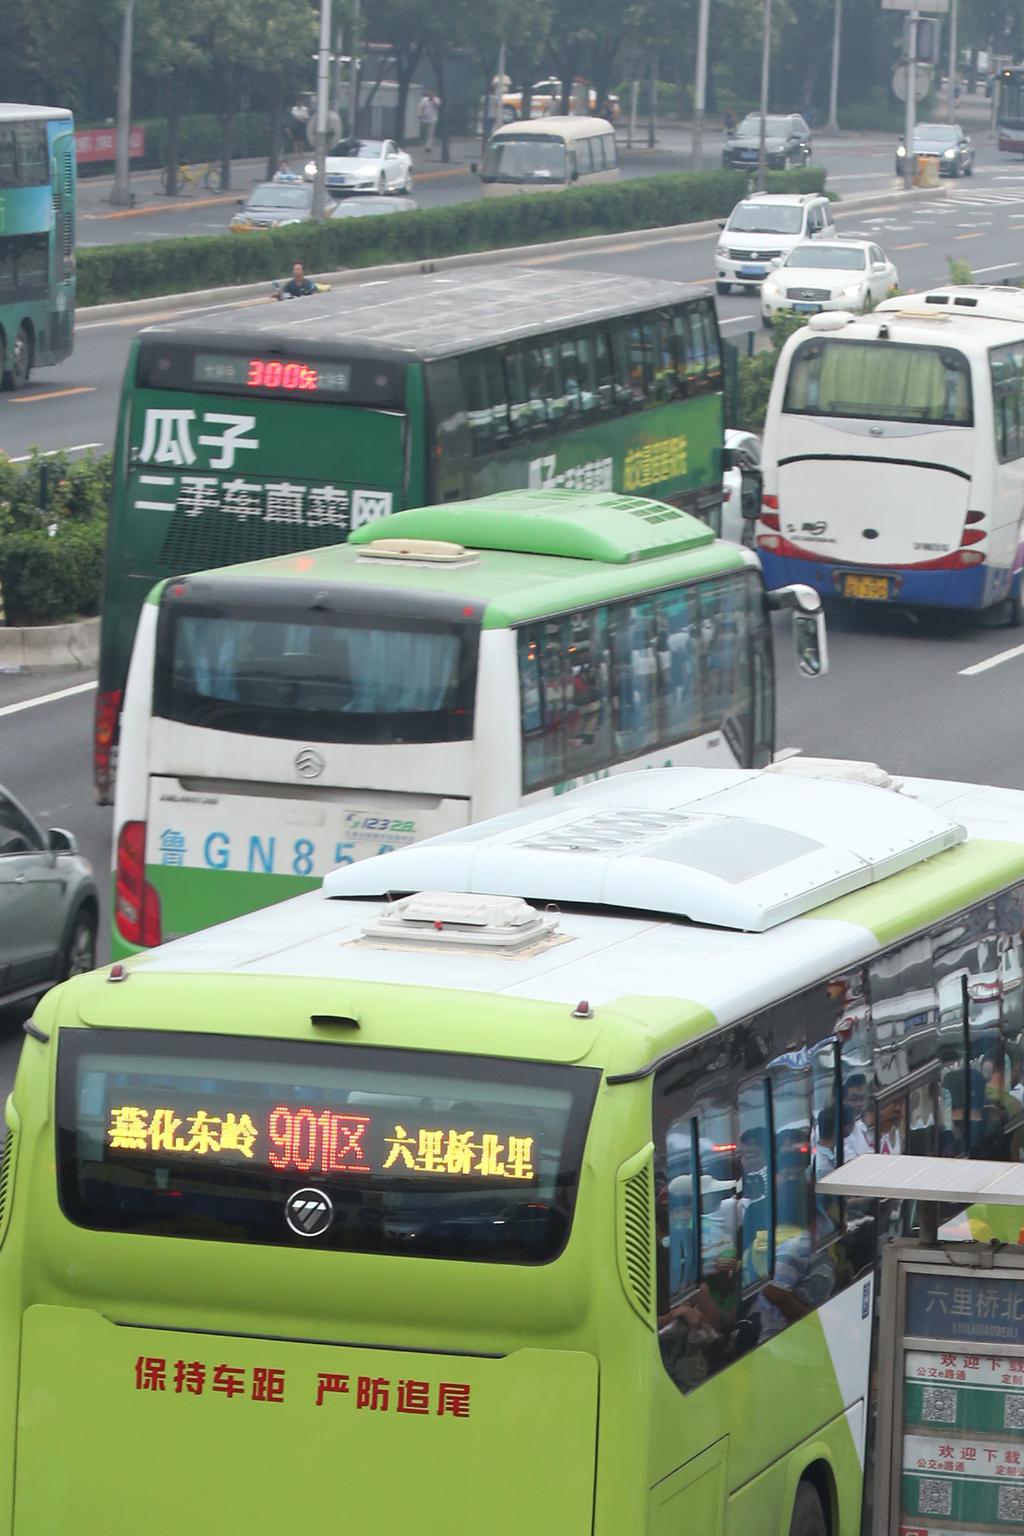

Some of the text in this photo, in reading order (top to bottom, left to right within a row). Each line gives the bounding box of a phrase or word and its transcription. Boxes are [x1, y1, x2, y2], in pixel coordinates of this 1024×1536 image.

[138, 408, 259, 470] 瓜子
[134, 475, 394, 529] 二手车直卖网
[268, 1104, 371, 1173] 901区
[383, 1125, 536, 1179] 六里桥北里
[134, 1356, 472, 1418] 保持车距 严防追尾
[938, 1445, 1021, 1465] 欢迎下载
